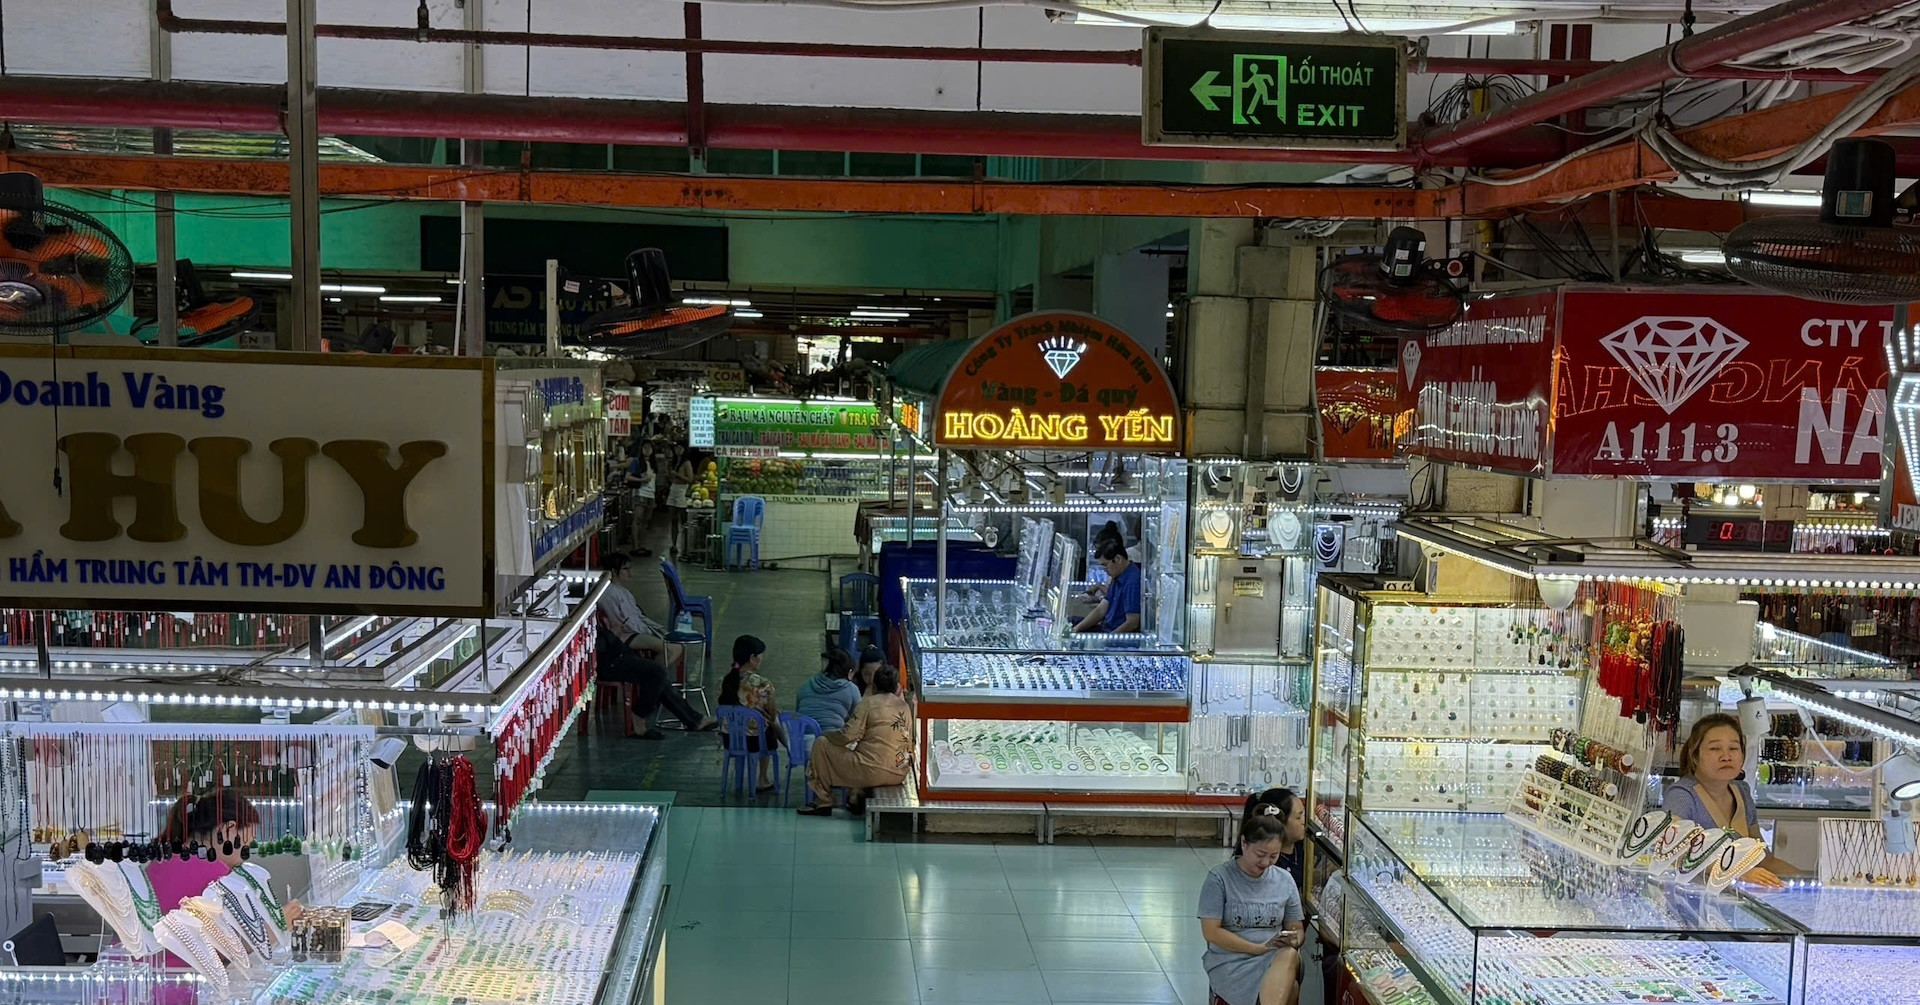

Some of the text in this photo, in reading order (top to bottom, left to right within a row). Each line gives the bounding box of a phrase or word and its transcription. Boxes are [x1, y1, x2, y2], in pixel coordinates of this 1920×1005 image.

[1289, 56, 1374, 86] LỐI THOÁT
[1298, 103, 1365, 127] EXIT
[1801, 318, 1868, 347] CTY
[122, 372, 226, 418] Vàng
[981, 380, 1037, 405] Vàng
[1096, 385, 1138, 407] quý
[729, 409, 750, 423] RAU
[752, 406, 766, 423] MÁ
[768, 407, 808, 425] NGUYÊN
[810, 405, 836, 426] CHẤT
[848, 409, 868, 426] TRÀ
[944, 408, 1088, 439] HOÀNG
[1099, 408, 1173, 441] YẾN
[1594, 421, 1739, 462] A111.3
[58, 432, 447, 548] HUY
[10, 550, 445, 592] HẦM TRUNG TÂM TM-DV AN ĐÔNG
